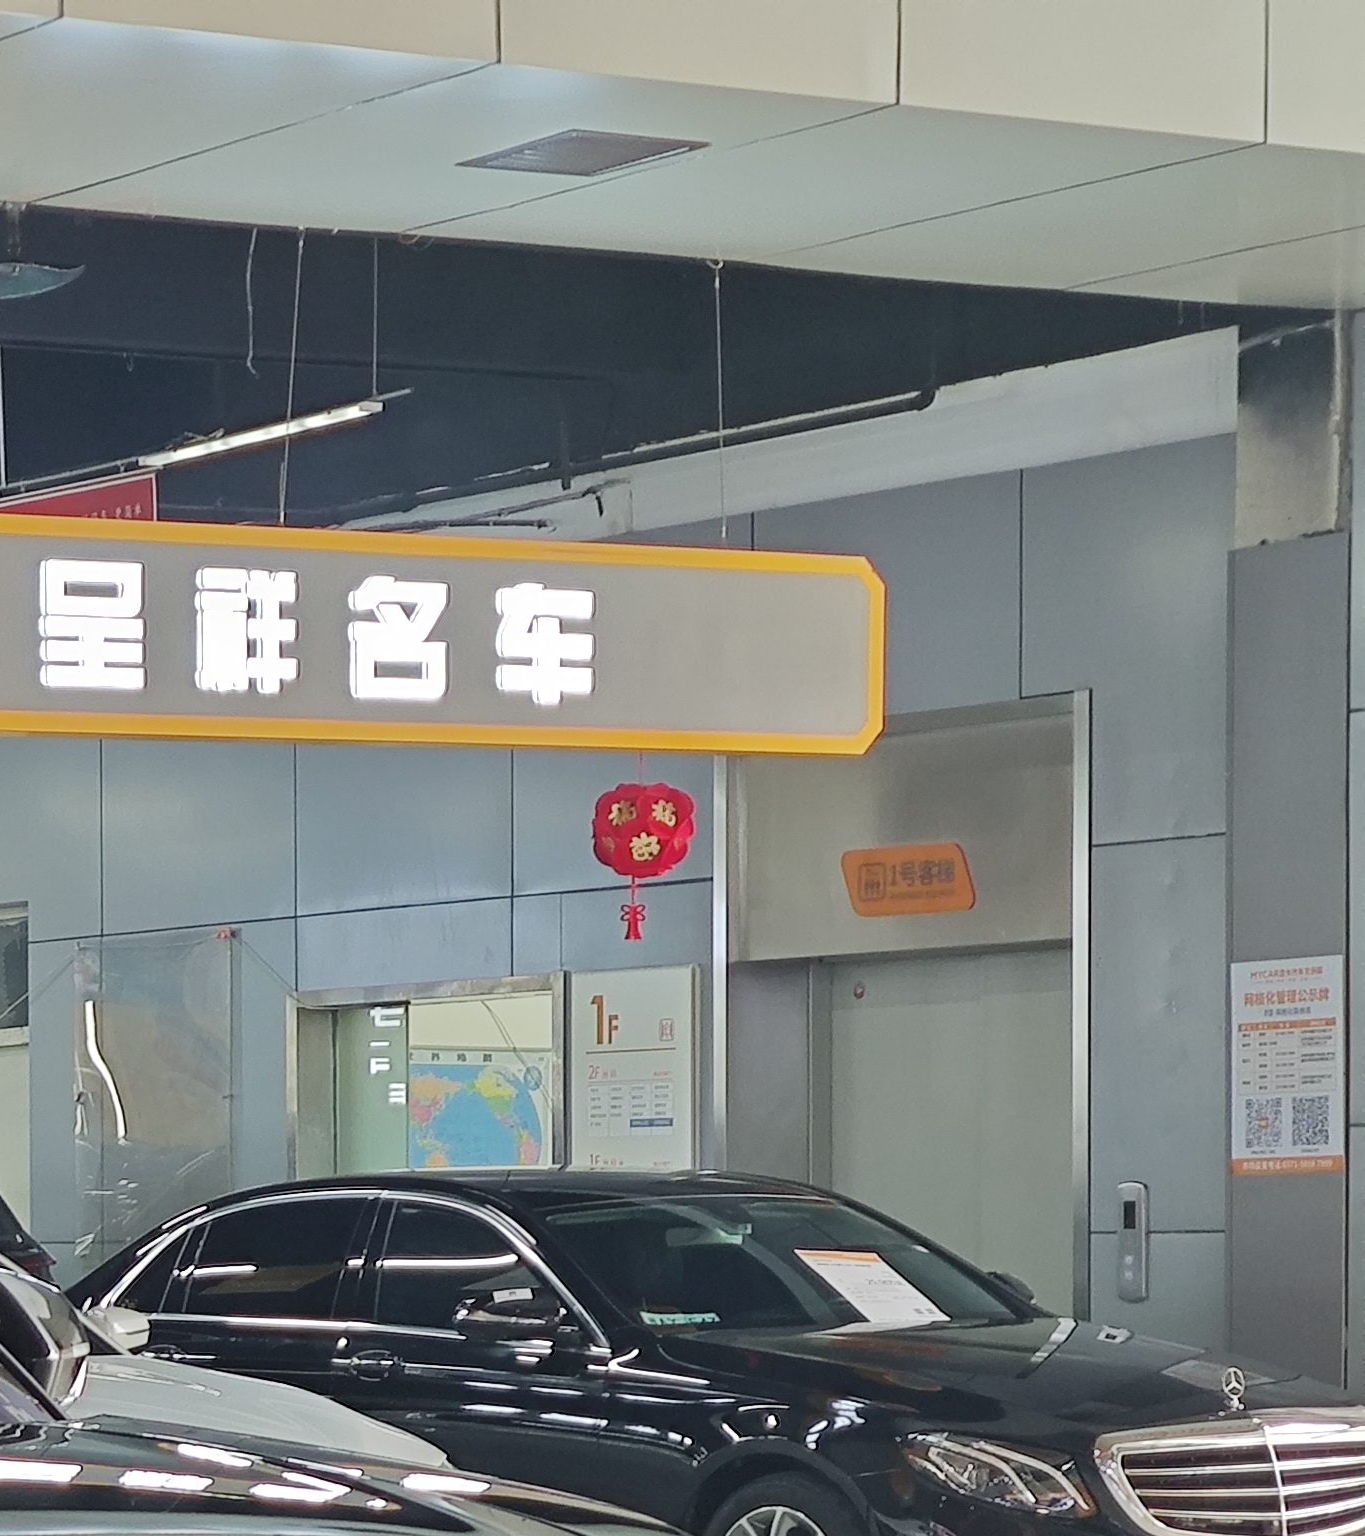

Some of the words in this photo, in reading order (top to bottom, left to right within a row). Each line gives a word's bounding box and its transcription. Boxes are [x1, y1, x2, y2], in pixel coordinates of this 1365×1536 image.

[38, 556, 599, 706] 呈祥名车
[589, 994, 619, 1045] 1F
[588, 1064, 601, 1080] 2F
